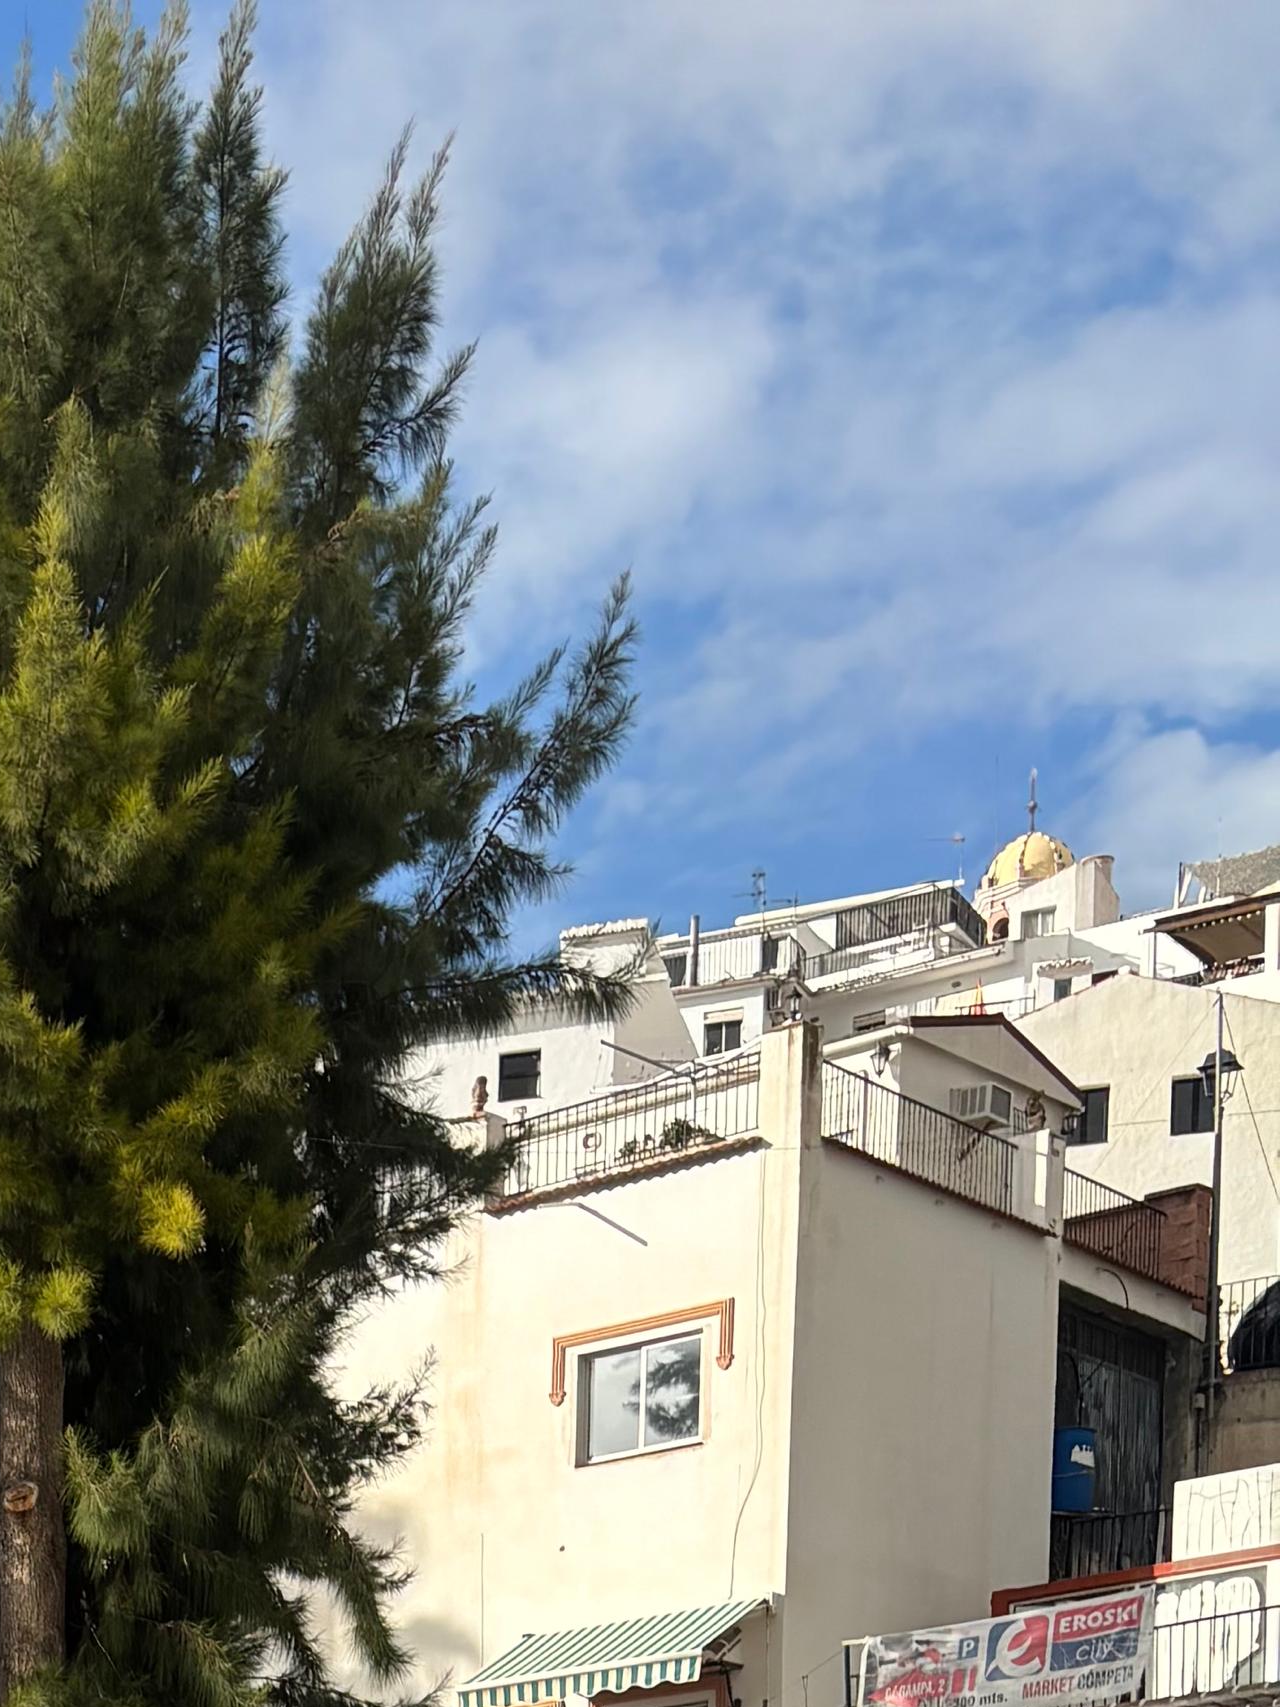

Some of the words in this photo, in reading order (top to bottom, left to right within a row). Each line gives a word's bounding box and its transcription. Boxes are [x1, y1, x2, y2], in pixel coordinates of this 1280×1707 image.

[1059, 1602, 1139, 1634] EROSKI
[962, 1639, 975, 1658] P
[1022, 1675, 1076, 1700] MARKET
